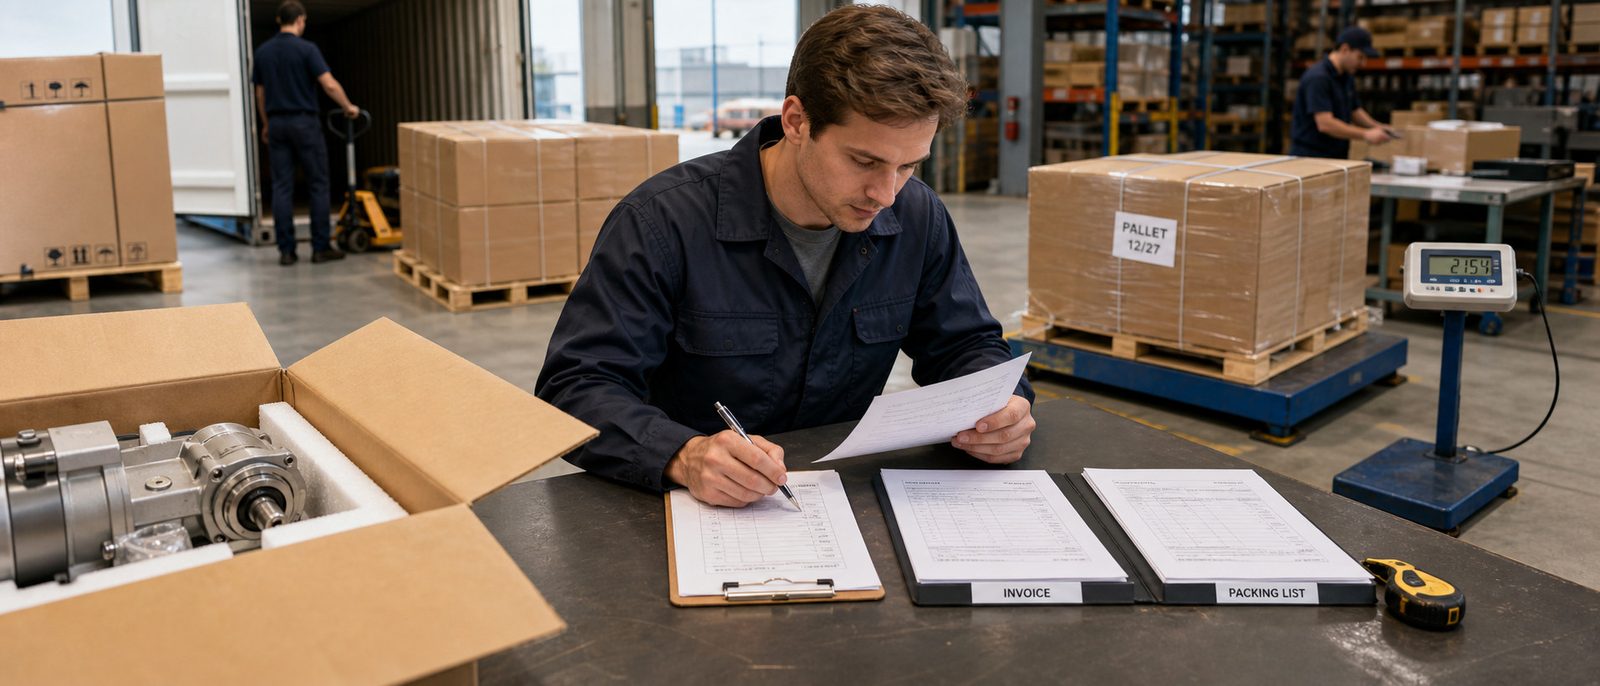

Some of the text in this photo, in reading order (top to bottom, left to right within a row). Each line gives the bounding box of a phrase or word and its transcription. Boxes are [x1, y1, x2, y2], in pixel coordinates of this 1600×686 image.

[1122, 221, 1168, 239] PALLET
[1128, 239, 1161, 255] 12/27
[1450, 258, 1489, 275] 2154
[1003, 588, 1051, 598] INVOICE
[1228, 588, 1306, 598] PACKING LIST
